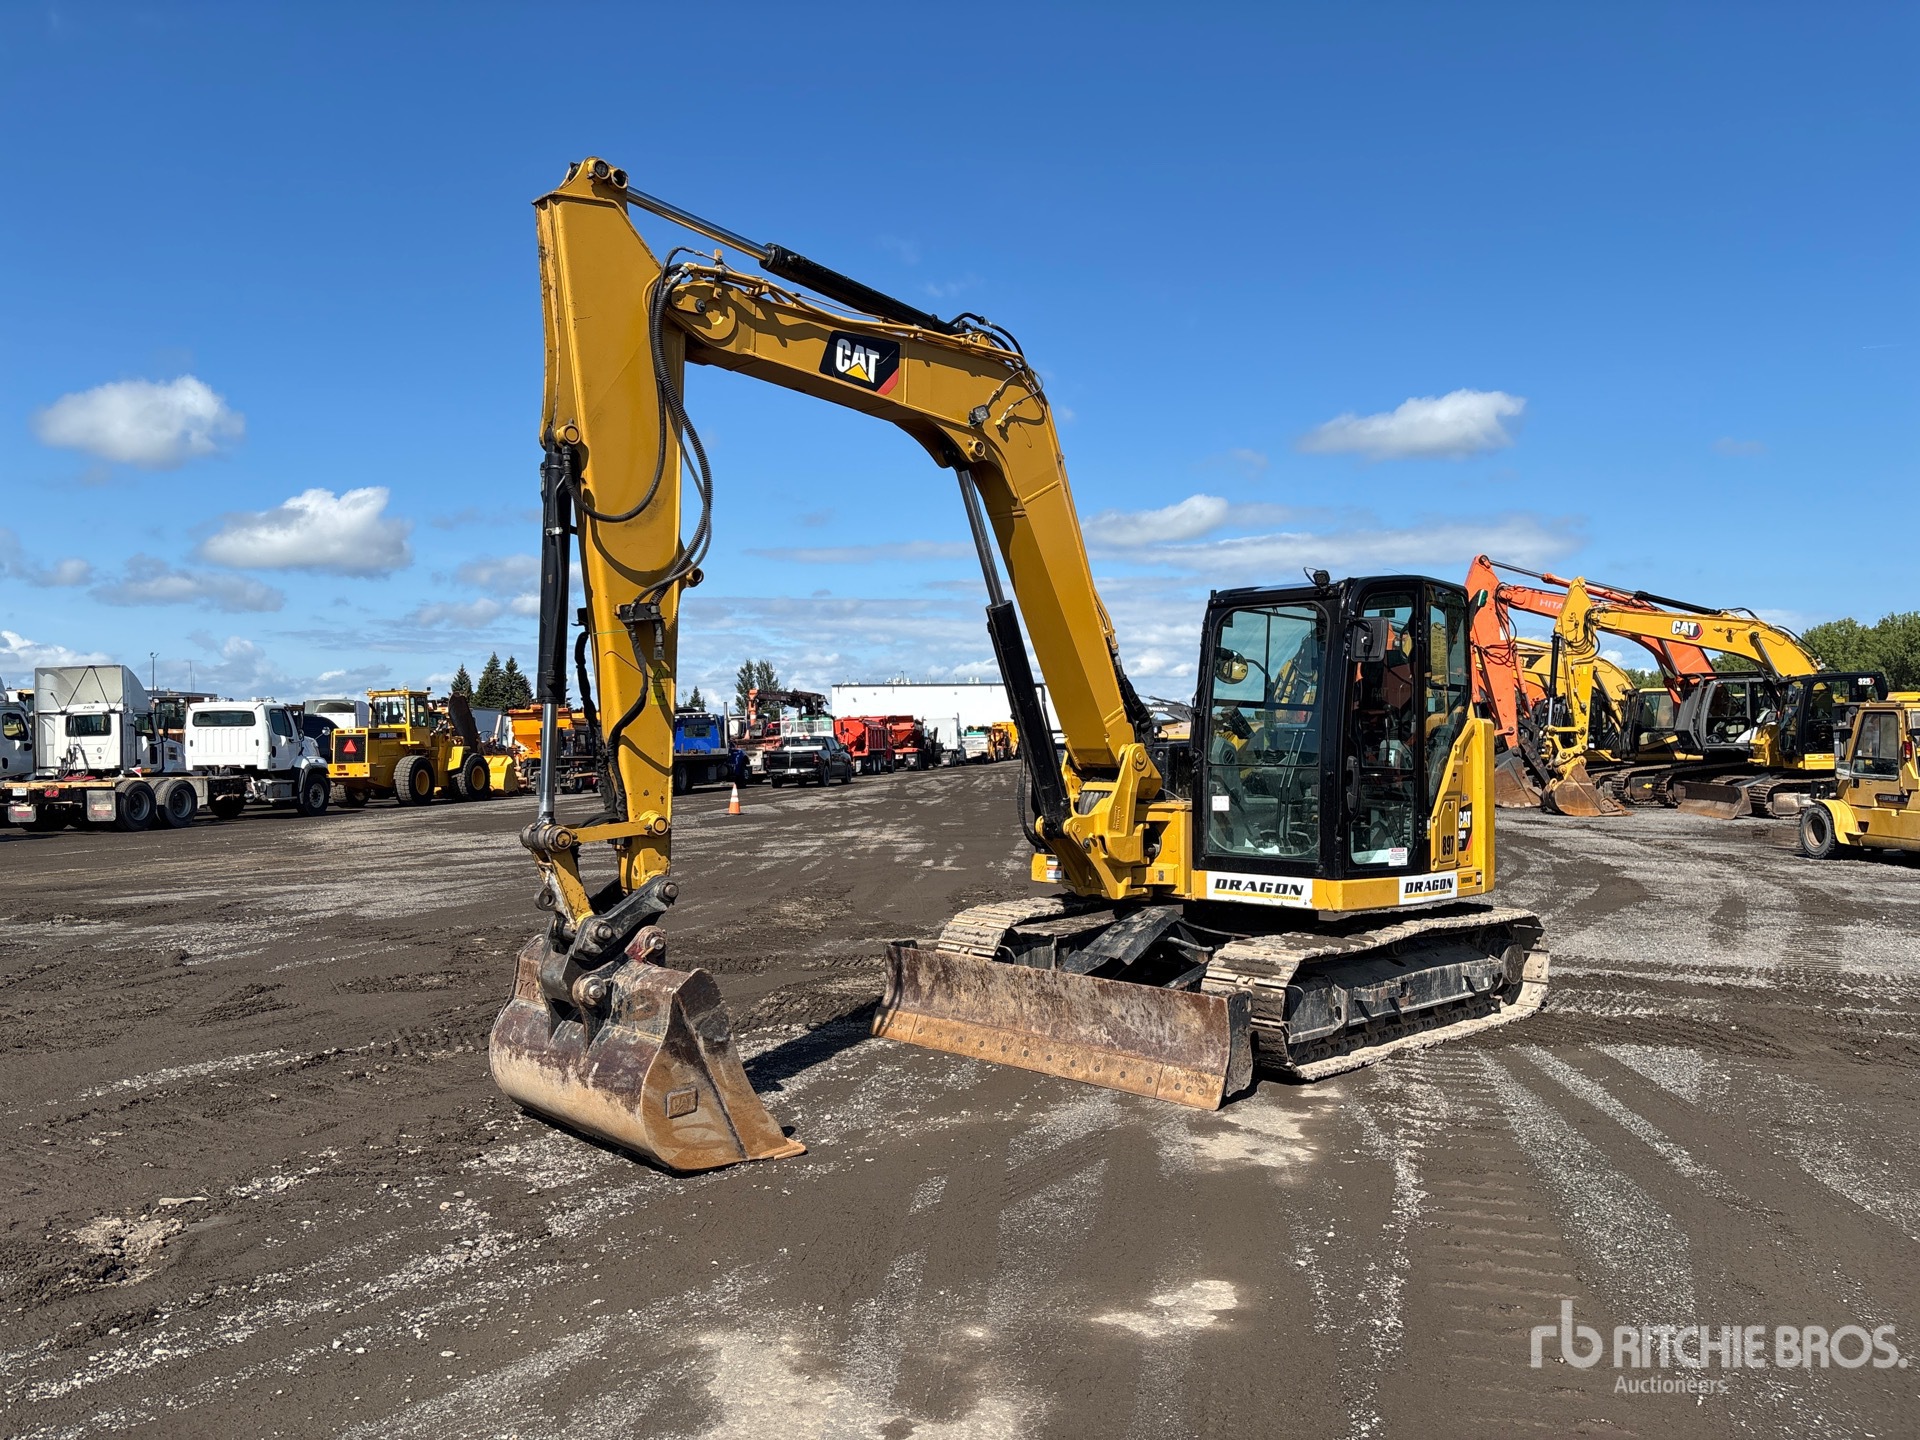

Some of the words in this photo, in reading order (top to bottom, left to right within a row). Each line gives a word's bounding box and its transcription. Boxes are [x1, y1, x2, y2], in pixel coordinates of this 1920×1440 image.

[835, 338, 880, 384] CAT
[1539, 599, 1563, 609] HITA
[1671, 620, 1697, 636] CAT
[1459, 810, 1472, 829] CAT
[1442, 835, 1454, 856] 897
[1214, 878, 1304, 896] DRAGON
[1404, 877, 1454, 894] DRAGON
